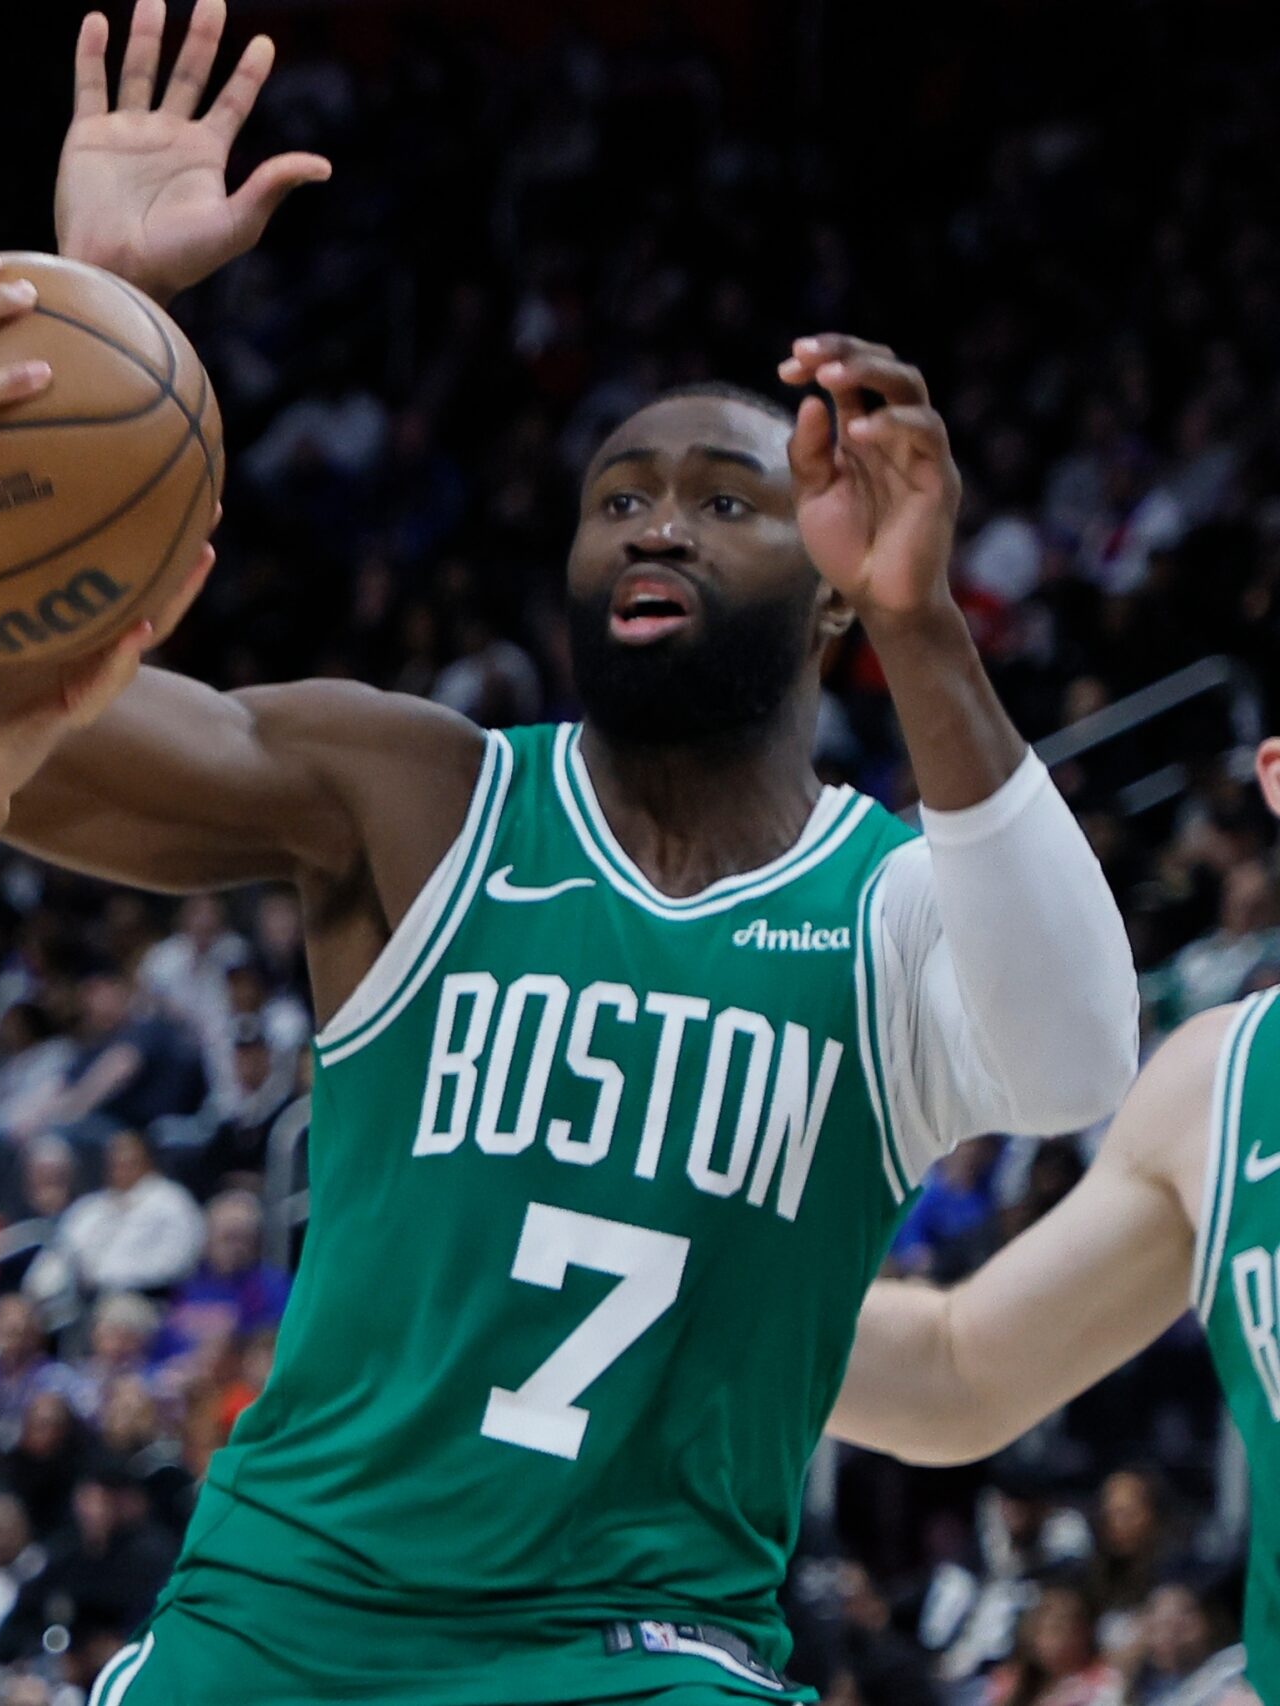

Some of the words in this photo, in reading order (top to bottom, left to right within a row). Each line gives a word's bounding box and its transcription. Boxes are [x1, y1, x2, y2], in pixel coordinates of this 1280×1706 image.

[732, 918, 851, 951] Amica
[412, 971, 844, 1222] BOSTON
[480, 1201, 691, 1460] 7
[1231, 1245, 1280, 1423] B
